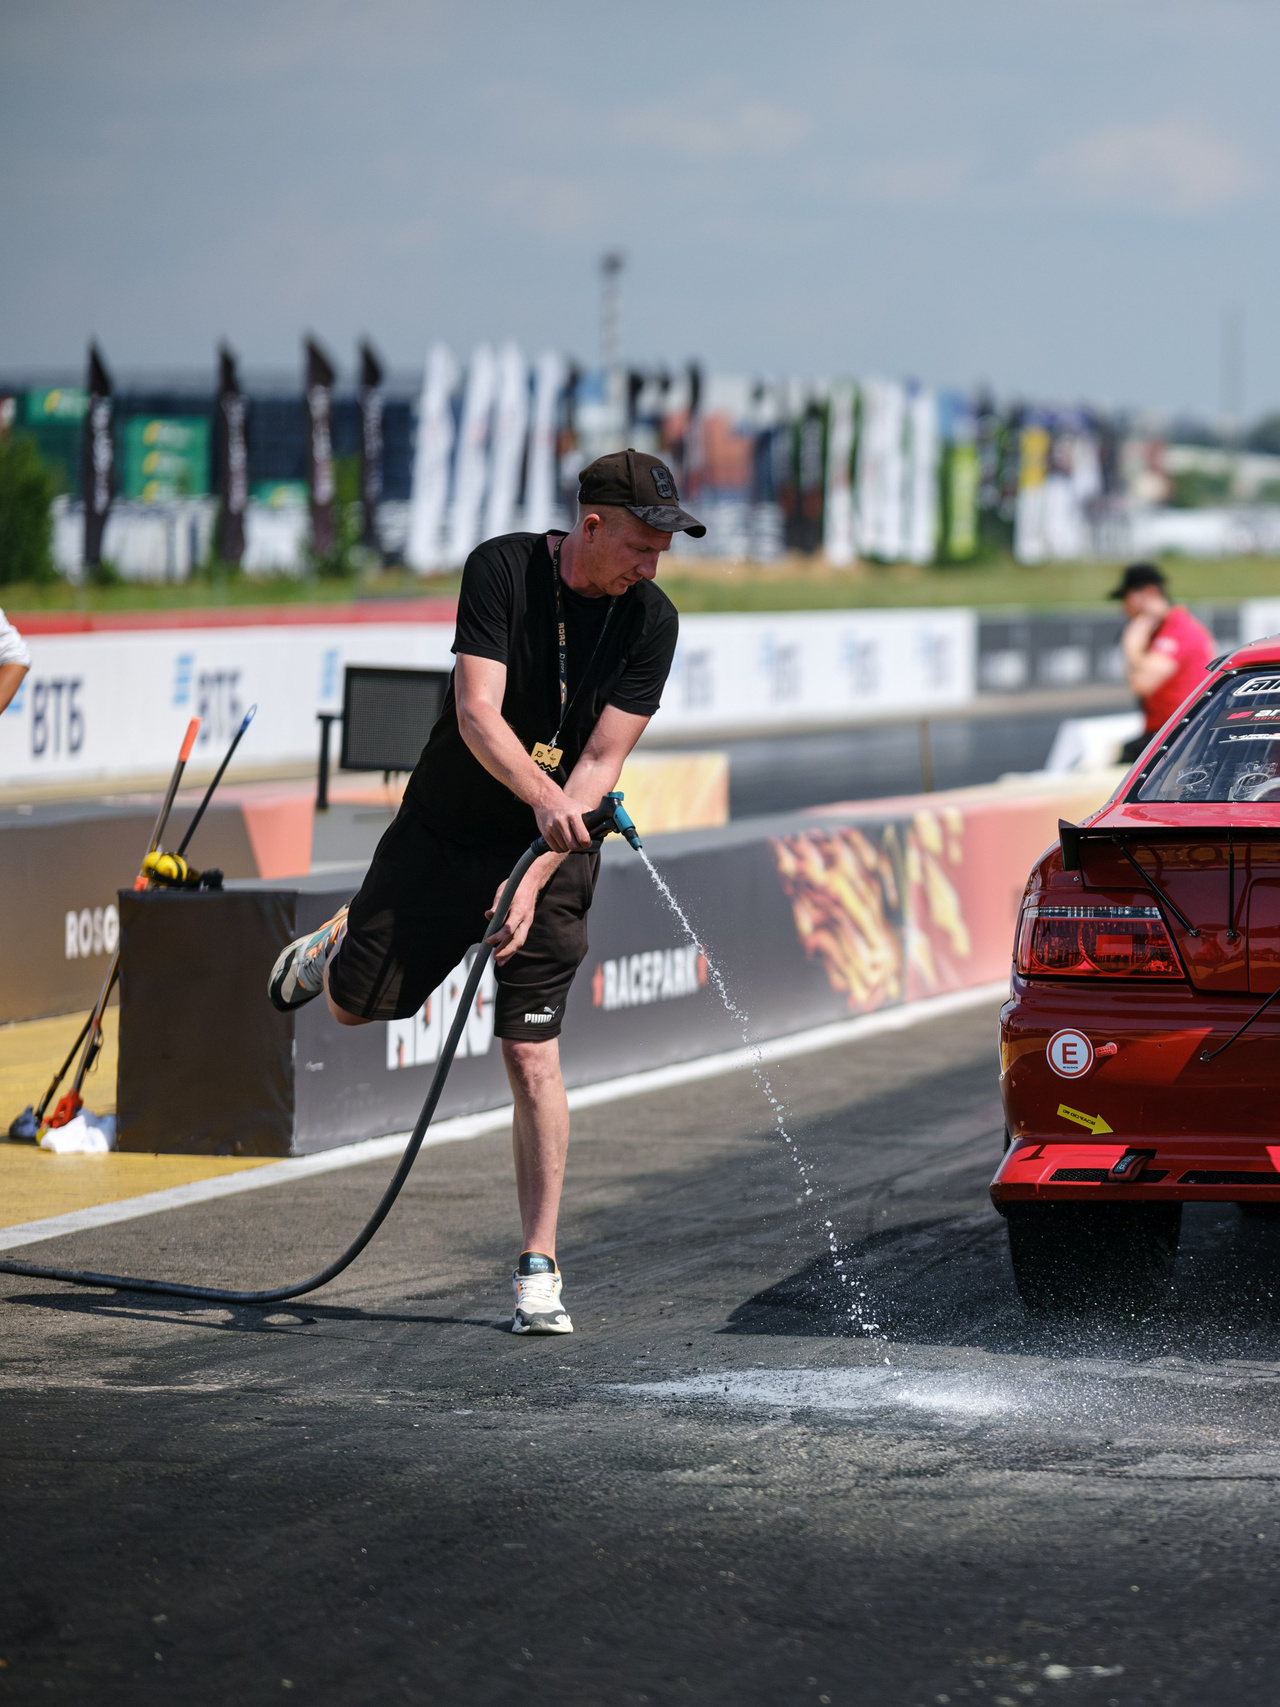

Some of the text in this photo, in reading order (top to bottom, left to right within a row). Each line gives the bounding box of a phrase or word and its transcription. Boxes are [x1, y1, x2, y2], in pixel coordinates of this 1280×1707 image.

[31, 674, 84, 758] ВТБ
[603, 946, 699, 1011] RACEPARK
[524, 1013, 553, 1024] PUMA
[1062, 1043, 1078, 1064] E
